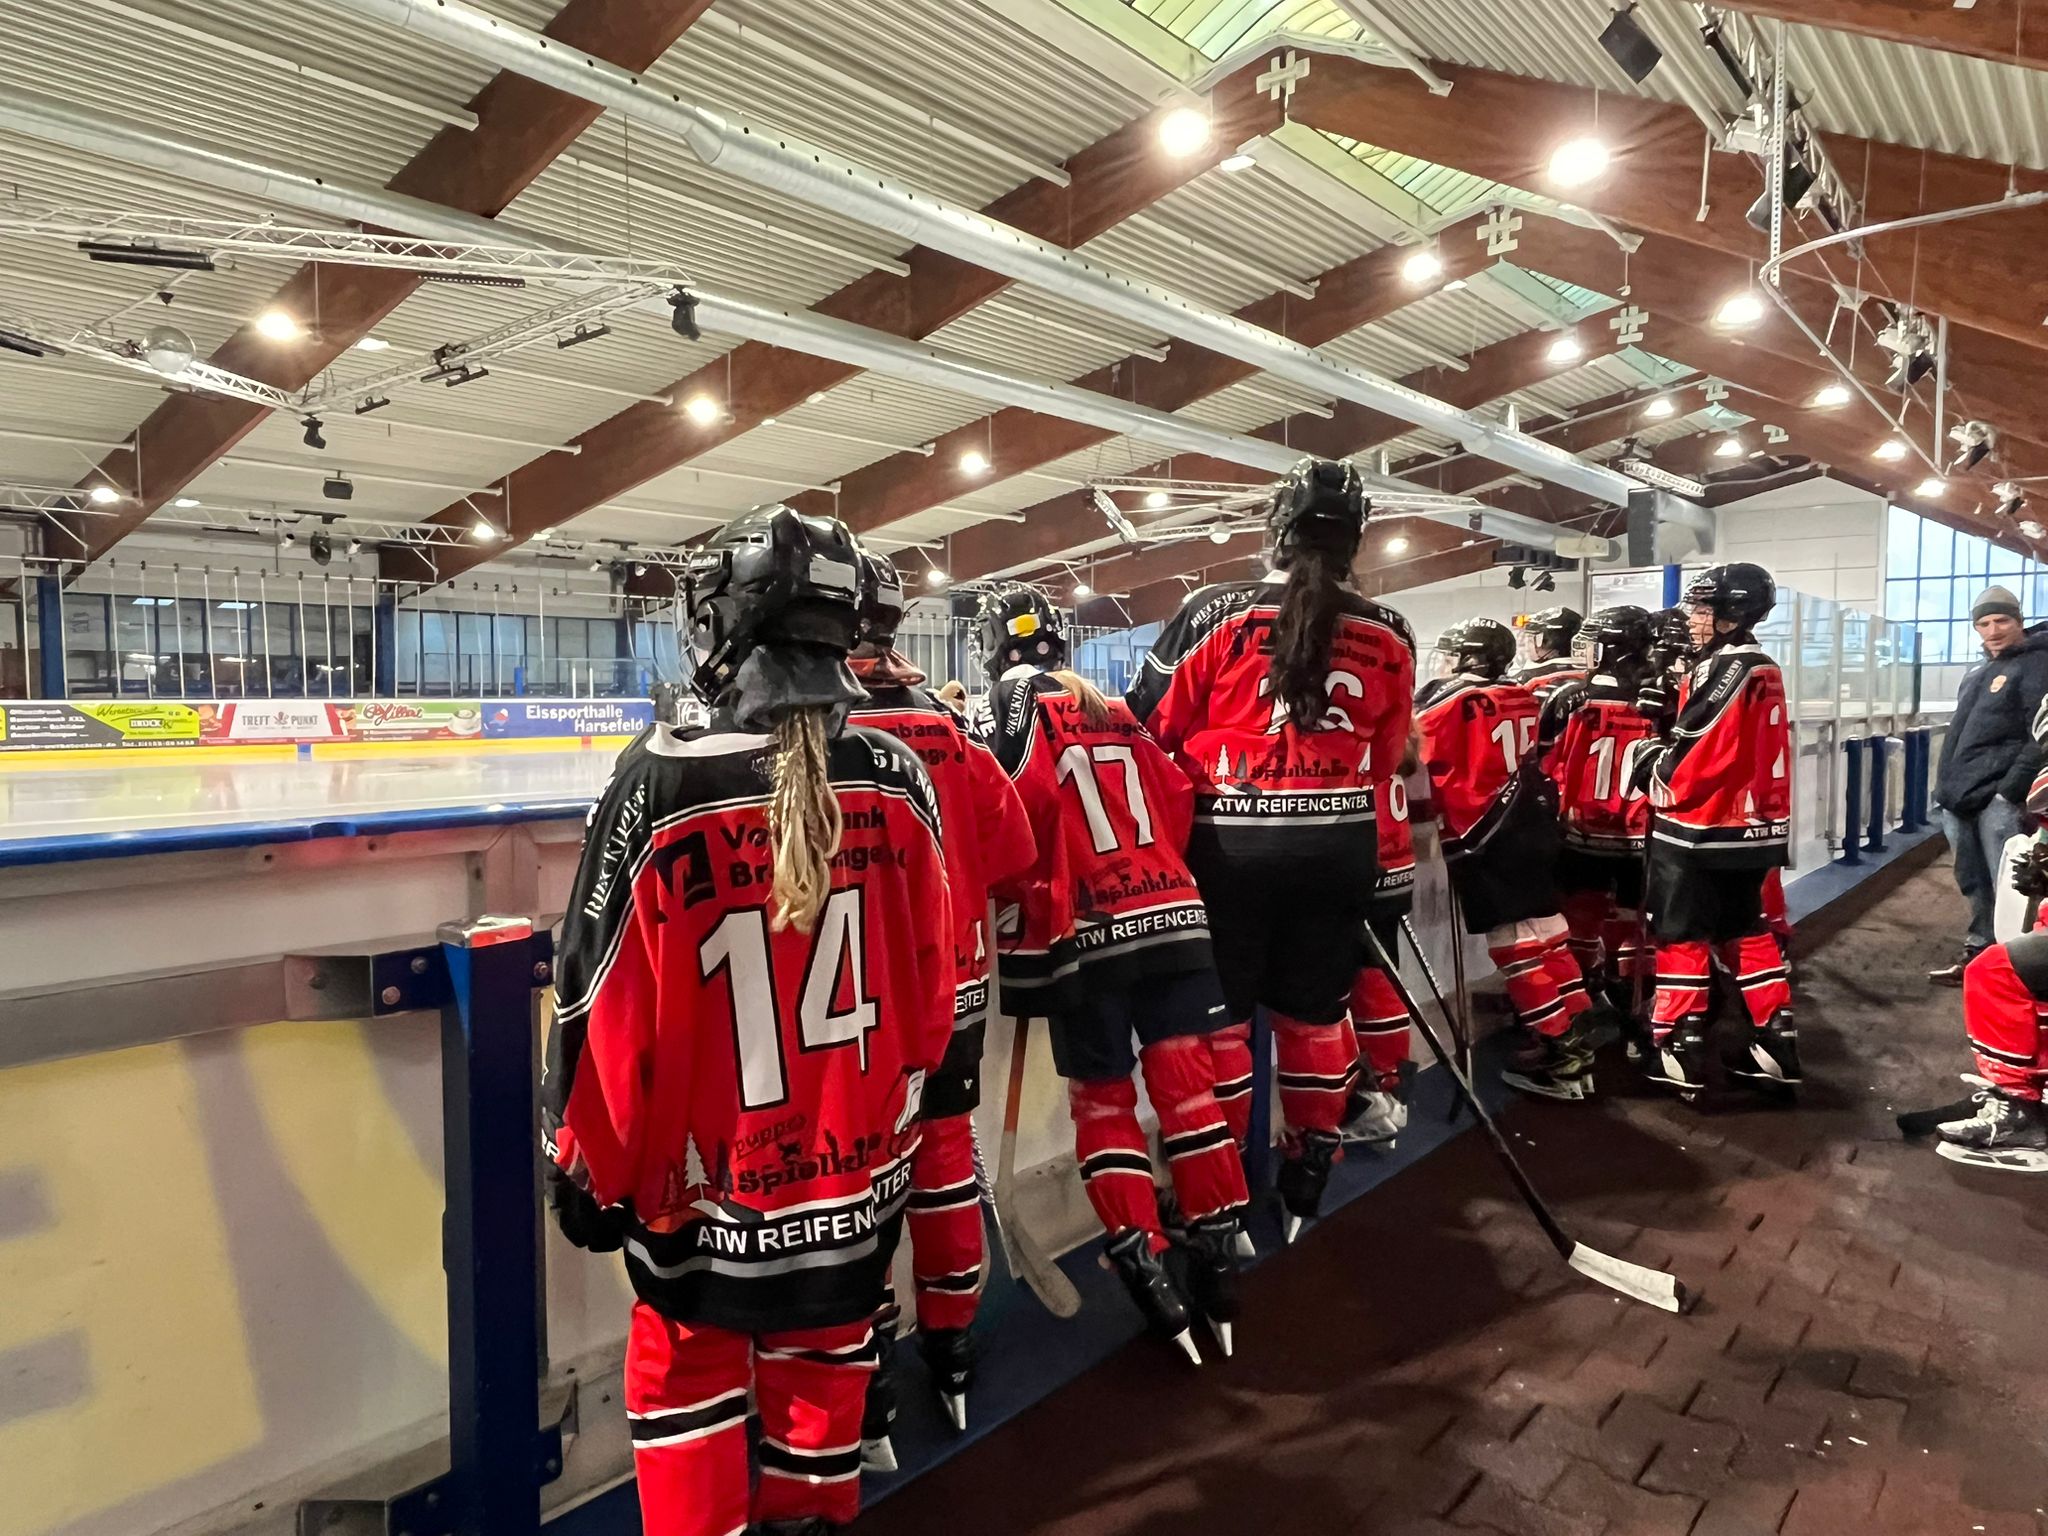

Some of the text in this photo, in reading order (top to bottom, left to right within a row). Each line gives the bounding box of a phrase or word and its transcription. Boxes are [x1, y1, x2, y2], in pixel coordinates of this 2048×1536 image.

[291, 715, 319, 726] PUNKT
[526, 704, 623, 722] Eissporthalle
[574, 717, 643, 733] Harsefeld
[1056, 745, 1154, 853] 17
[1212, 795, 1368, 813] ATW REIFENCENTER
[700, 889, 876, 1107] 14
[697, 1226, 748, 1255] ATW
